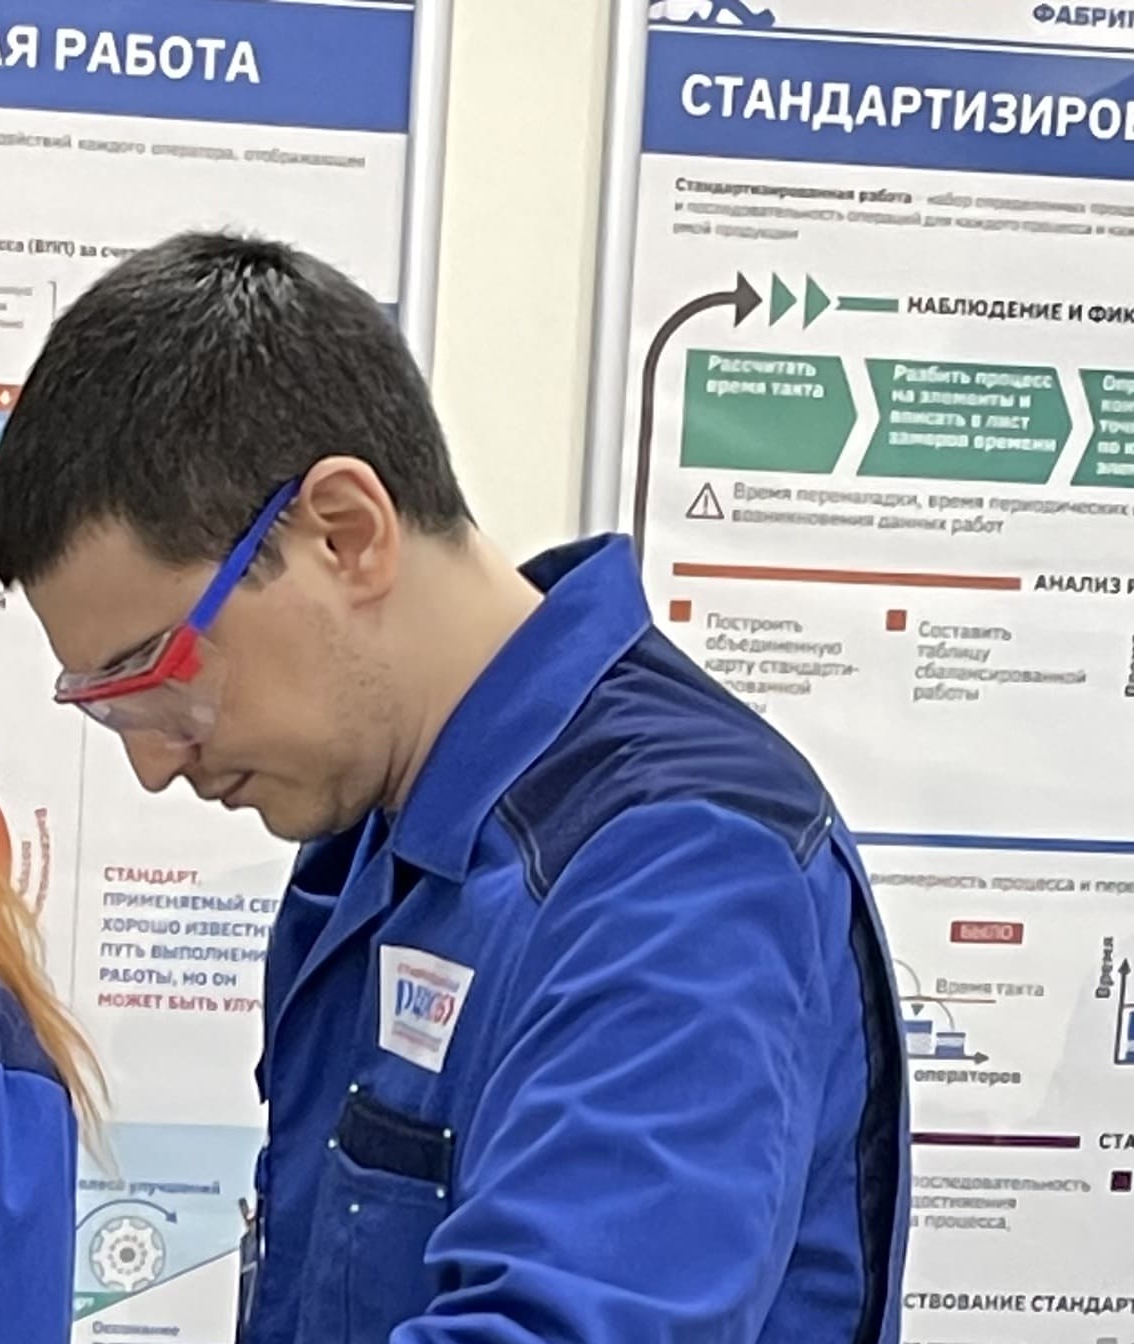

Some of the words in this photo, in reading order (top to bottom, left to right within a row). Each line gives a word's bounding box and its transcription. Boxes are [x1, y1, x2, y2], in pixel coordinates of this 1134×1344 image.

[54, 28, 261, 84] РАБОТА
[675, 177, 855, 200] Стандартизированная
[858, 188, 913, 204] работа
[906, 296, 1063, 321] НАБЛЮДЕНИЕ
[1068, 304, 1083, 322] И
[707, 354, 817, 377] Рассчитать
[893, 364, 971, 385] Разбить
[974, 372, 1054, 390] процесс
[706, 379, 767, 398] время
[770, 381, 825, 399] такта
[733, 481, 792, 502] Время
[928, 495, 984, 511] время
[950, 515, 1004, 536] работ
[1033, 574, 1121, 595] АНАЛИЗ
[706, 612, 803, 634] Построить
[918, 620, 1012, 641] Составить
[916, 641, 992, 664] таблицу
[704, 658, 756, 676] карту
[912, 682, 980, 703] работы
[102, 891, 245, 912] ПРИМЕНЯЕМЫЙ
[101, 917, 181, 935] ХОРОШО
[99, 942, 146, 959] ПУТЬ
[150, 945, 267, 963] ВЫПОЛНЕНИ
[99, 967, 178, 987] РАБОТЫ,
[182, 971, 208, 986] НО
[212, 972, 238, 987] ОН
[935, 978, 992, 997] Время
[995, 982, 1045, 998] такта
[97, 992, 164, 1009] МОЖЕТ
[168, 995, 218, 1012] БЫТЬ
[913, 1069, 1022, 1087] операторов
[903, 1292, 1026, 1312] СТВОВАНИЕ
